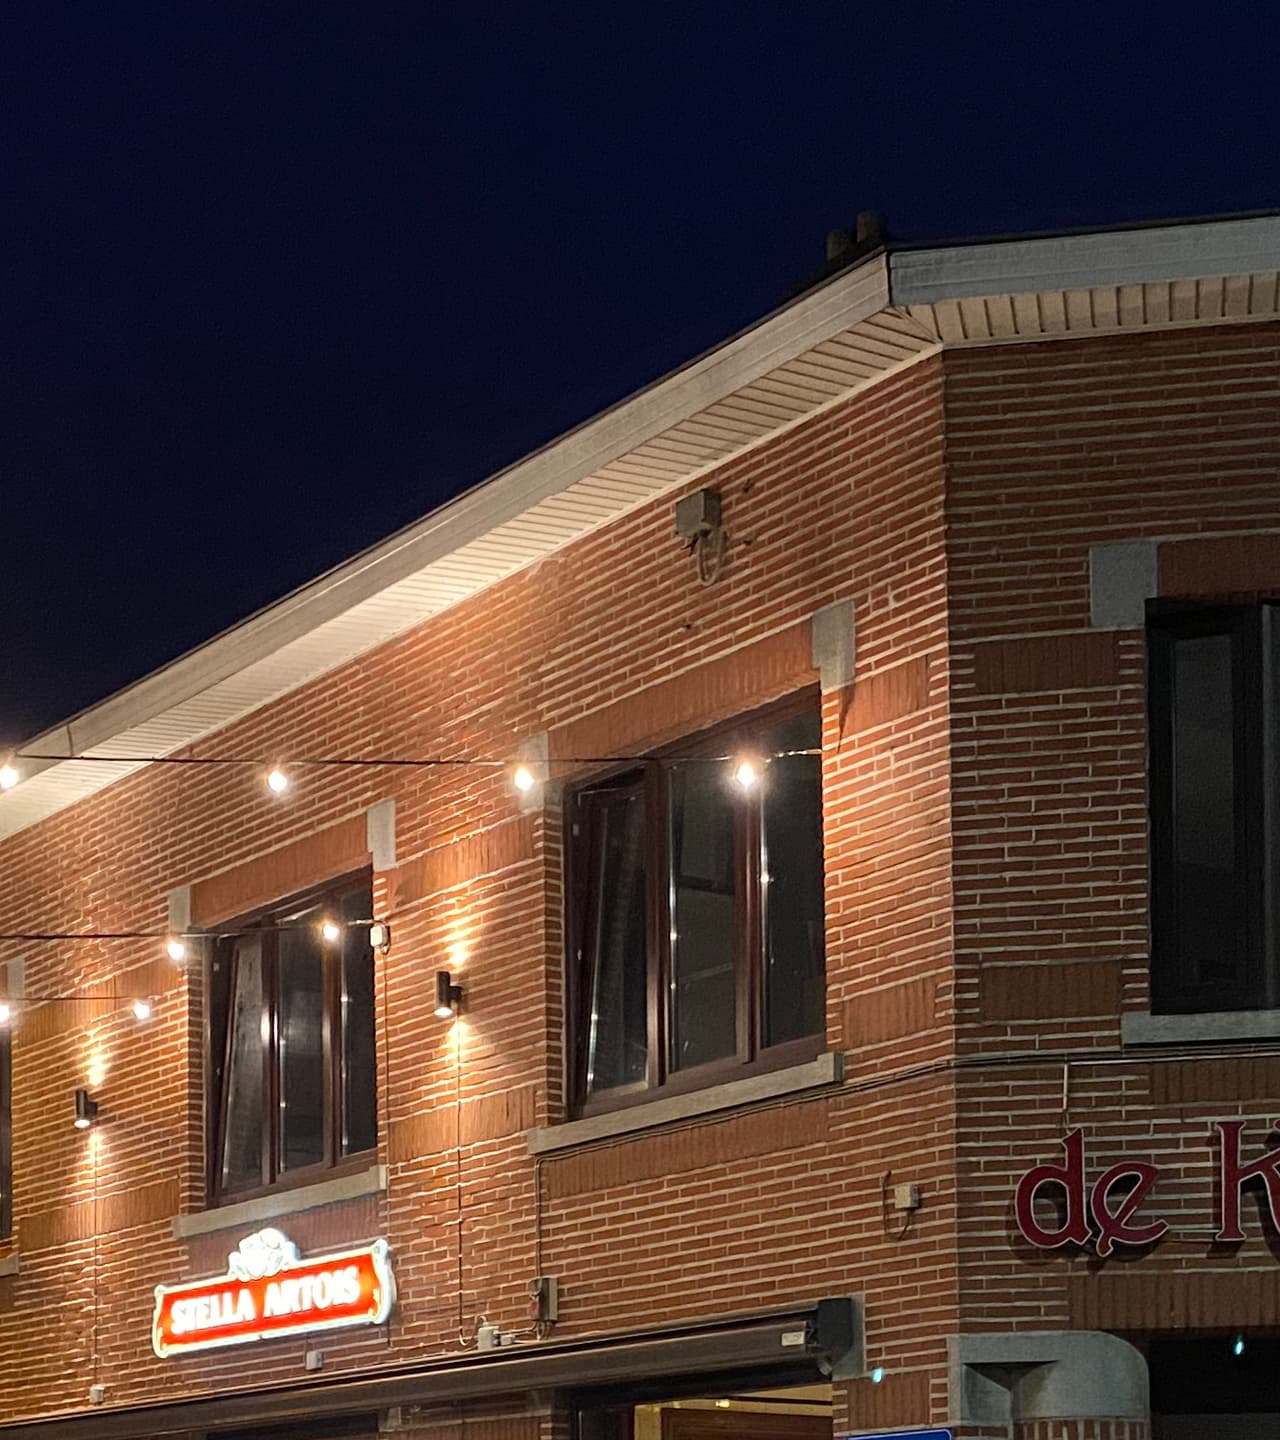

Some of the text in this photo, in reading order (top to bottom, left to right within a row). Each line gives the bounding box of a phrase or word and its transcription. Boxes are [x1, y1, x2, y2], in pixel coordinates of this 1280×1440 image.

[1015, 1126, 1169, 1257] de
[170, 1265, 362, 1335] STELLA ARTOIS
